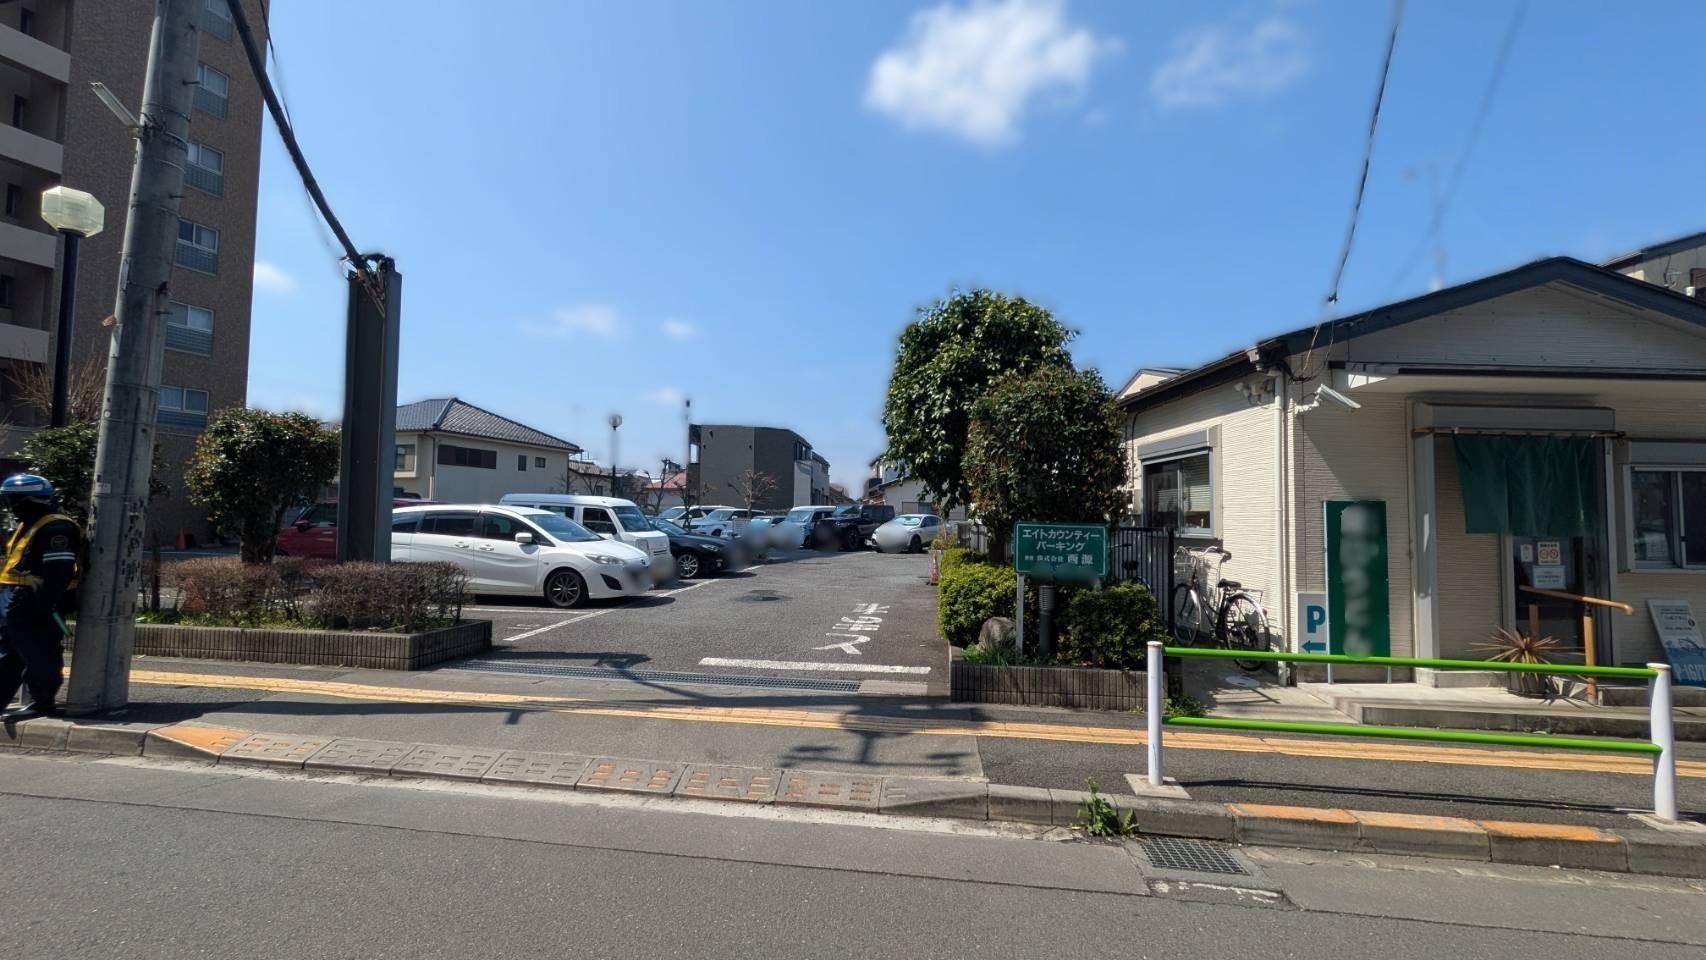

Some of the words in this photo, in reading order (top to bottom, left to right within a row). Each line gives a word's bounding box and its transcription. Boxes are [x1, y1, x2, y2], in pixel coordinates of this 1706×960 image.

[1022, 529, 1100, 540] エイトカウンティー
[1036, 541, 1086, 552] パーキング
[1306, 605, 1326, 633] P
